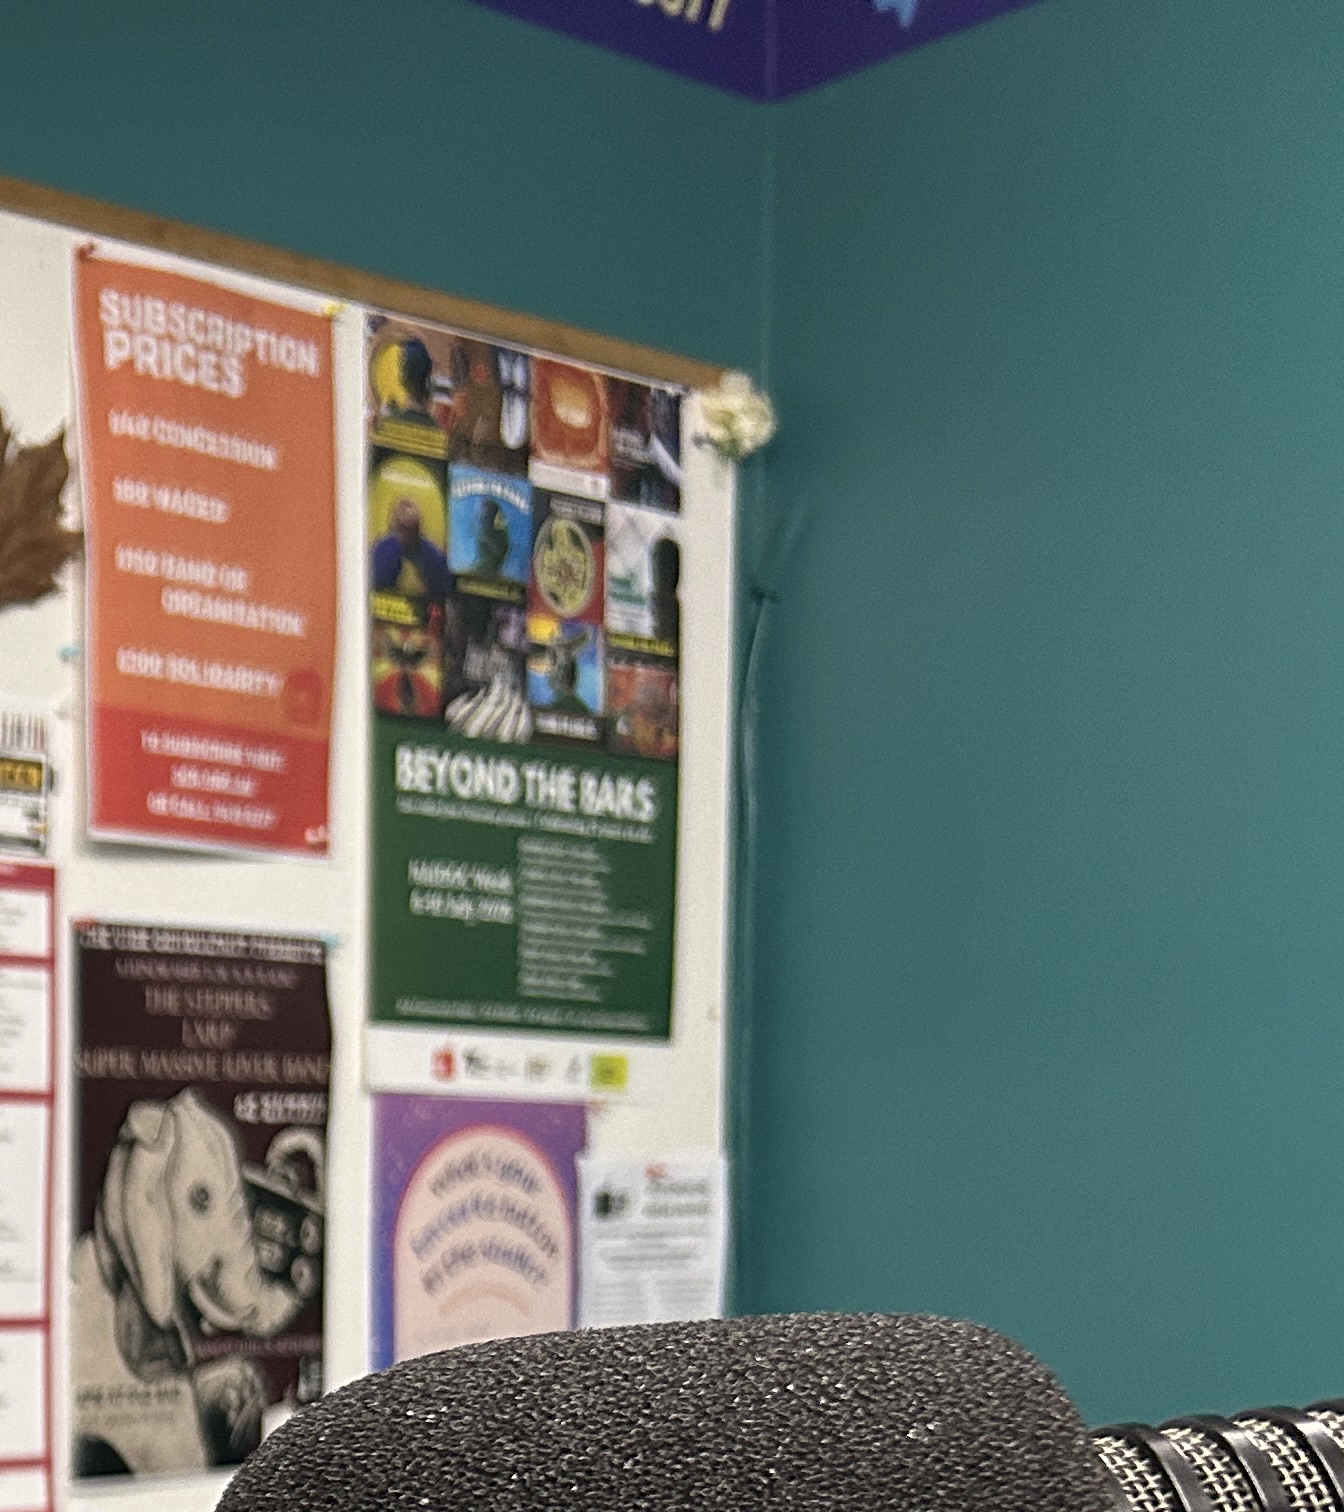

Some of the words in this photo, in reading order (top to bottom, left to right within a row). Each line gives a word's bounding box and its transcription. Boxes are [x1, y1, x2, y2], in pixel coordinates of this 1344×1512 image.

[98, 287, 320, 378] SUBSCRIPTION
[104, 327, 245, 398] PRICES
[394, 744, 521, 805] BEYOND
[523, 763, 577, 808] THE
[579, 770, 656, 823] BARS
